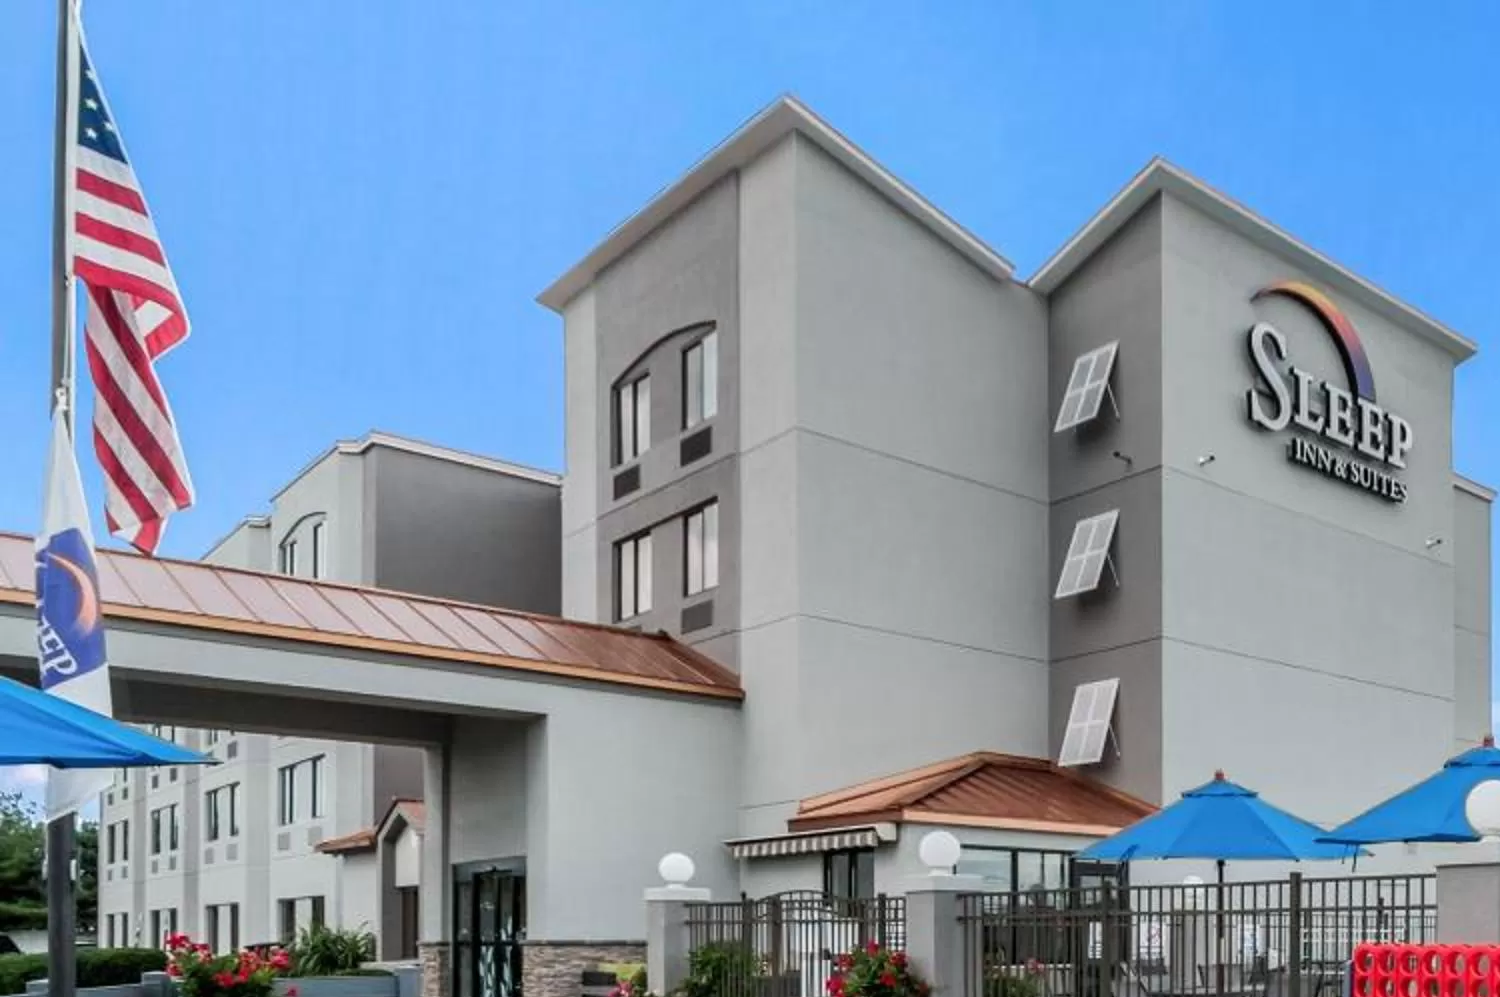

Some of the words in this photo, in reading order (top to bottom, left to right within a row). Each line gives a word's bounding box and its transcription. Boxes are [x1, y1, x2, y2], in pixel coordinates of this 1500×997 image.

[1250, 321, 1413, 469] SLEEP
[1295, 437, 1332, 473] INN
[1334, 457, 1347, 479] &
[1351, 461, 1408, 504] SUITES
